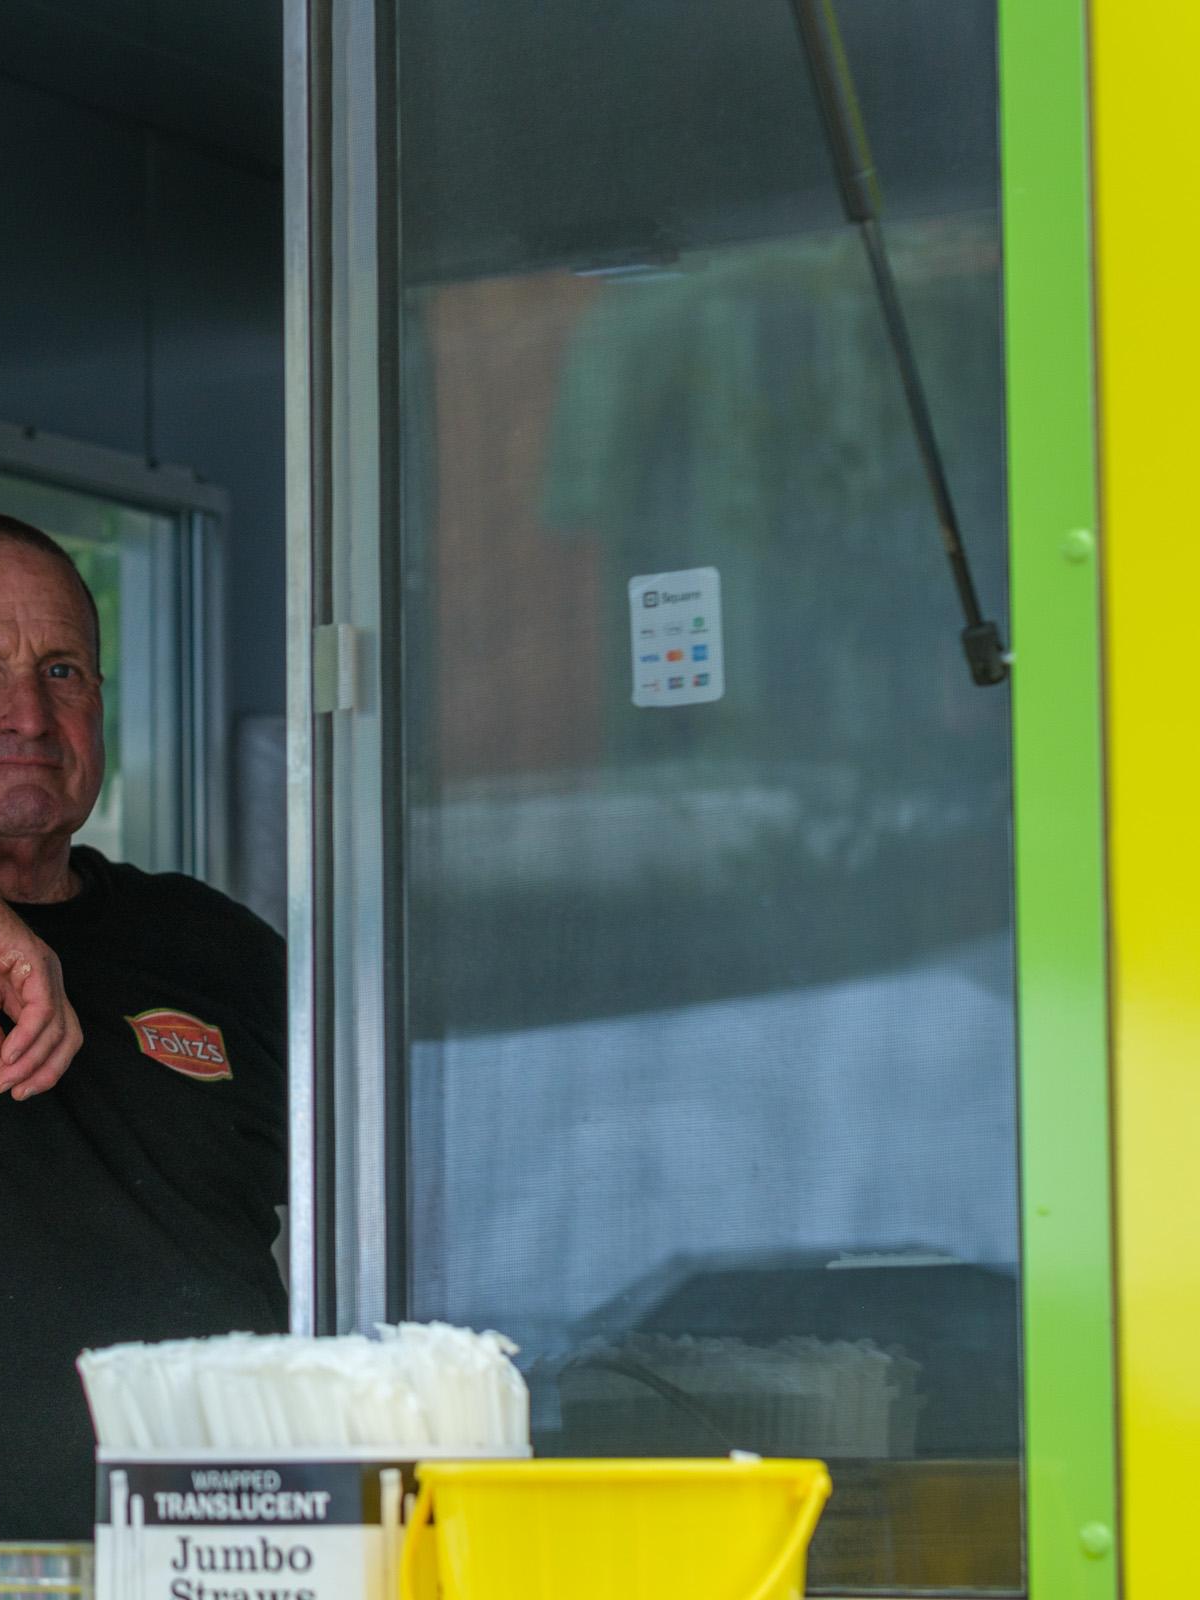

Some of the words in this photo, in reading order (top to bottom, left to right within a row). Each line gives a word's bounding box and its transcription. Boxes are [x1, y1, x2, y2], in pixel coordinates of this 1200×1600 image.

[142, 1026, 224, 1063] Foltz's
[191, 1469, 282, 1492] WRAPPED
[154, 1491, 331, 1520] TRANSLUCENT
[171, 1535, 313, 1573] Jumbo
